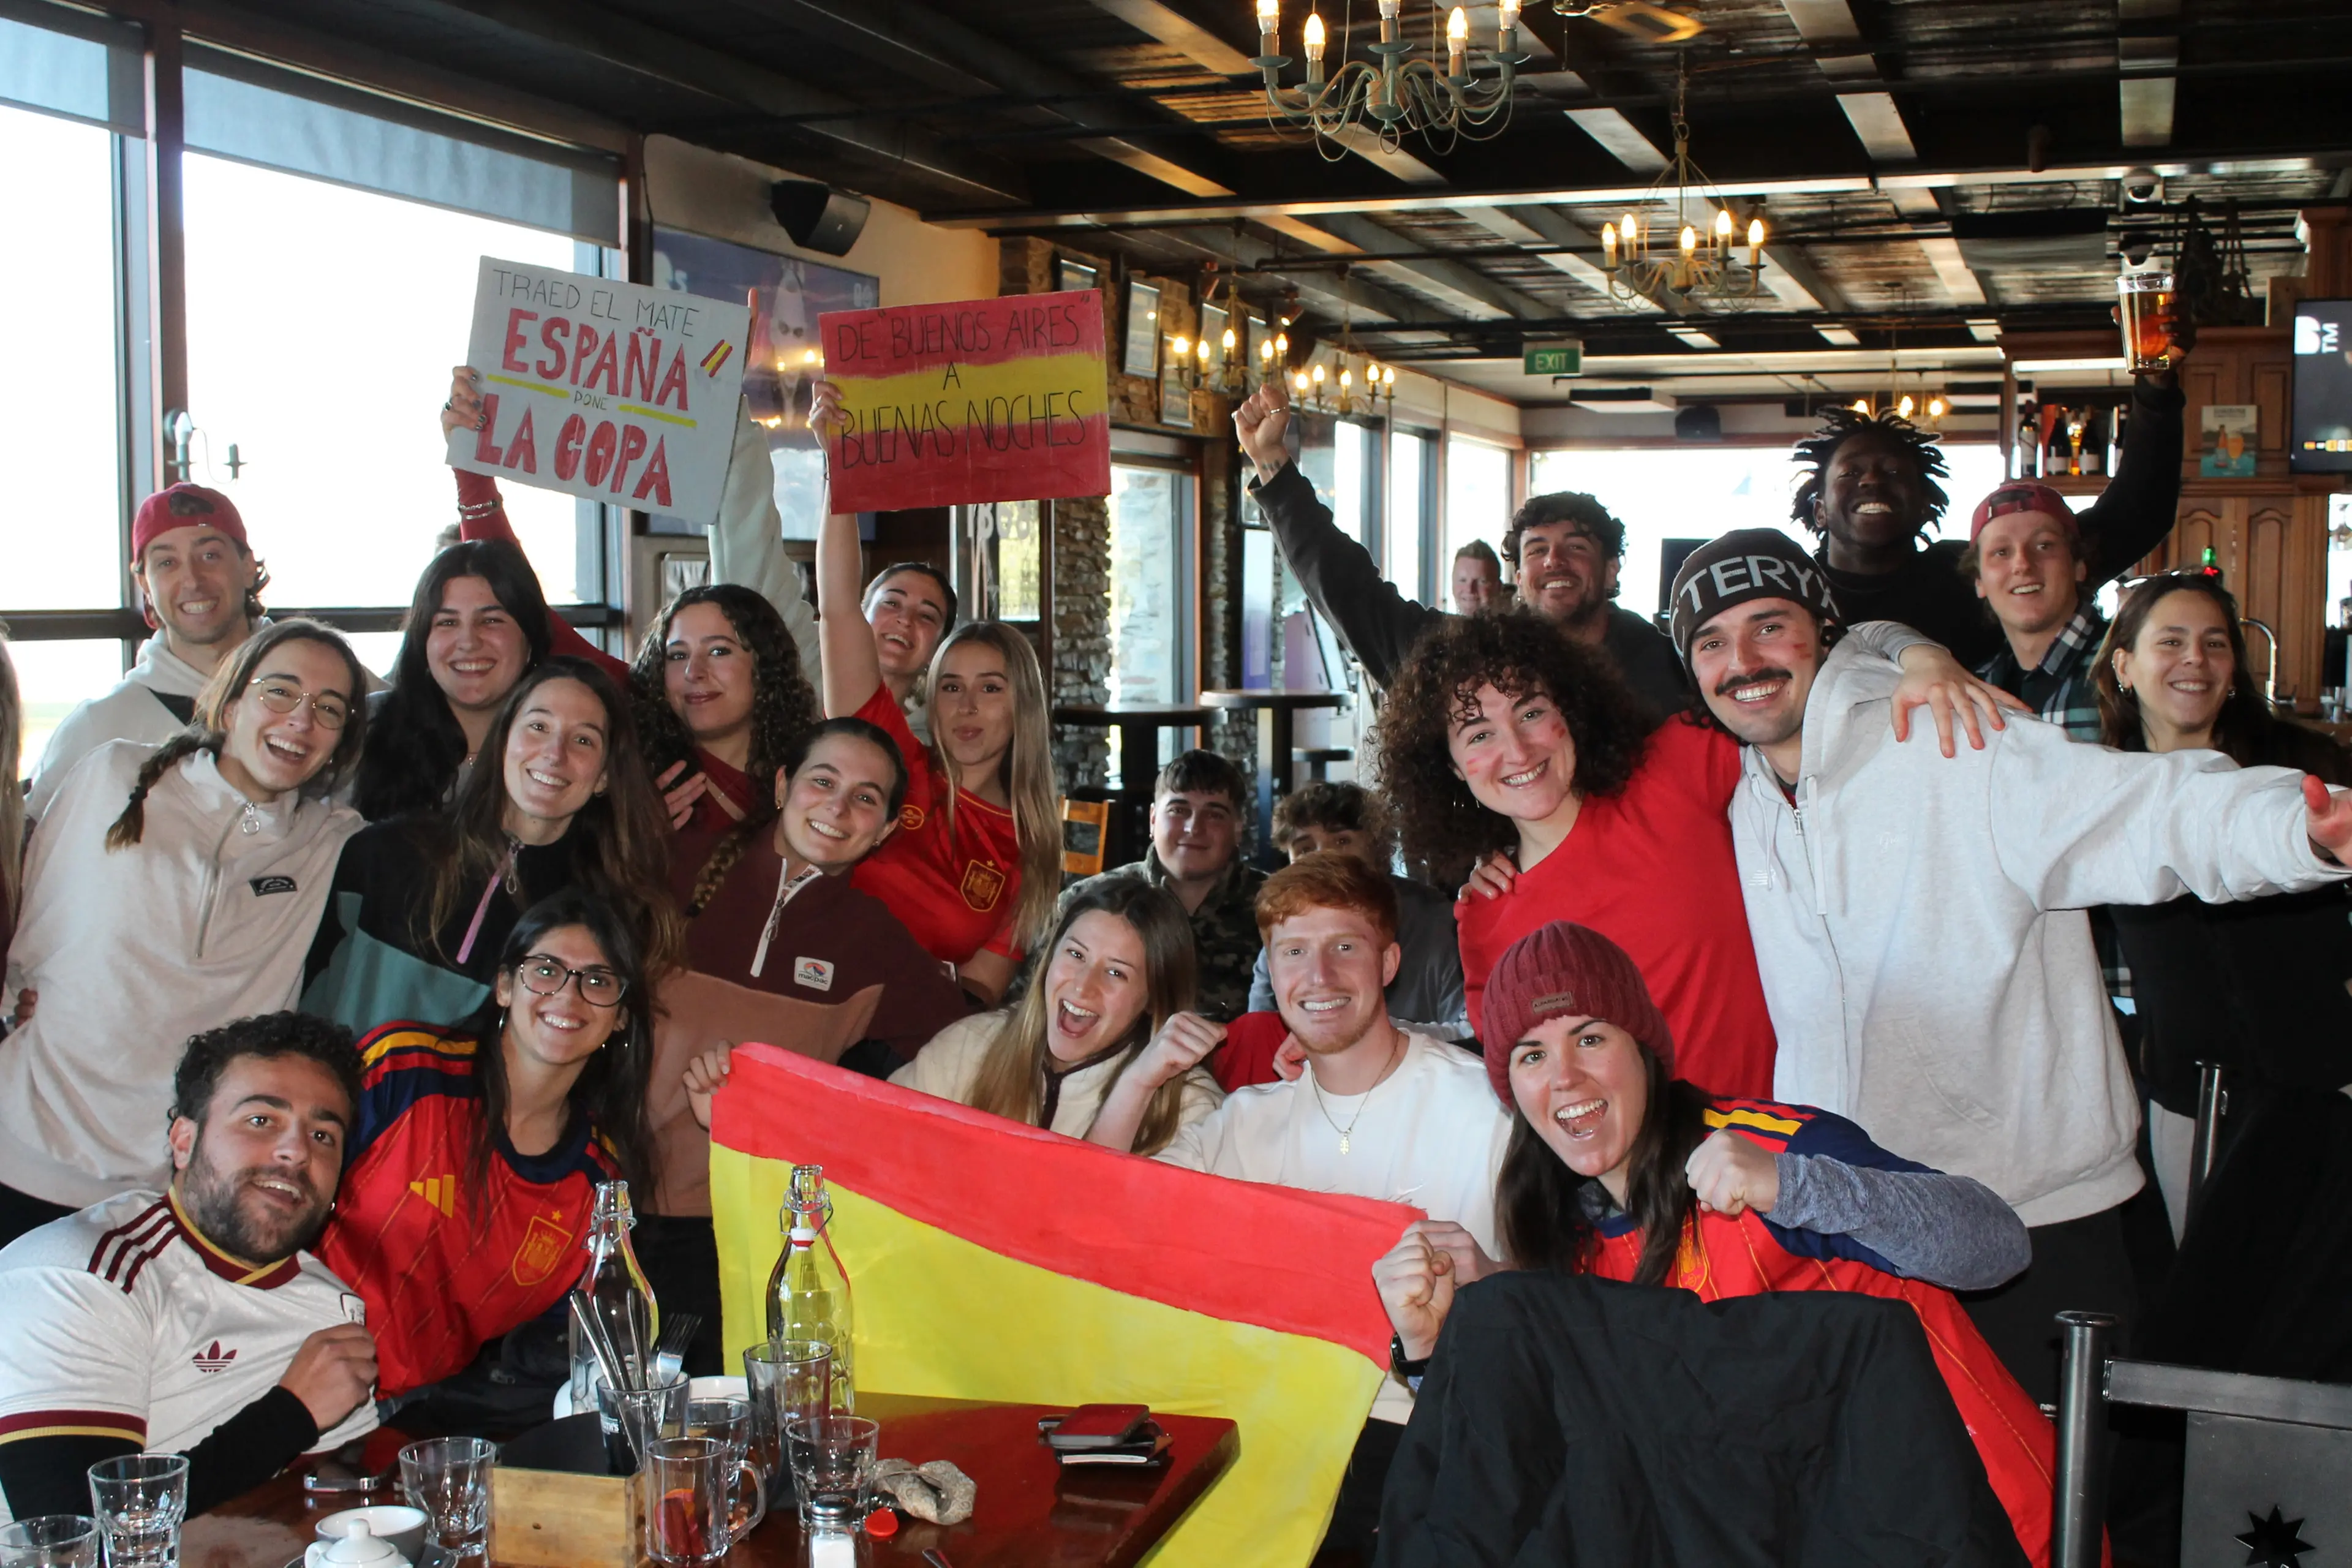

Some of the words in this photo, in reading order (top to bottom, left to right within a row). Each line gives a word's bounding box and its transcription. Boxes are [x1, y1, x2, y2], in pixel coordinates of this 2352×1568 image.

[492, 269, 581, 310] TRAED
[590, 290, 622, 322] EL
[635, 298, 700, 337] MATE
[501, 307, 689, 412] ESPAÑA
[838, 320, 878, 363] DE
[1534, 353, 1568, 371] EXIT
[942, 361, 962, 391] A
[474, 393, 537, 475] LA
[553, 413, 673, 507] COPA
[840, 399, 956, 470] BUENAS
[965, 390, 1086, 454] NOCHES
[798, 973, 828, 985] macpac
